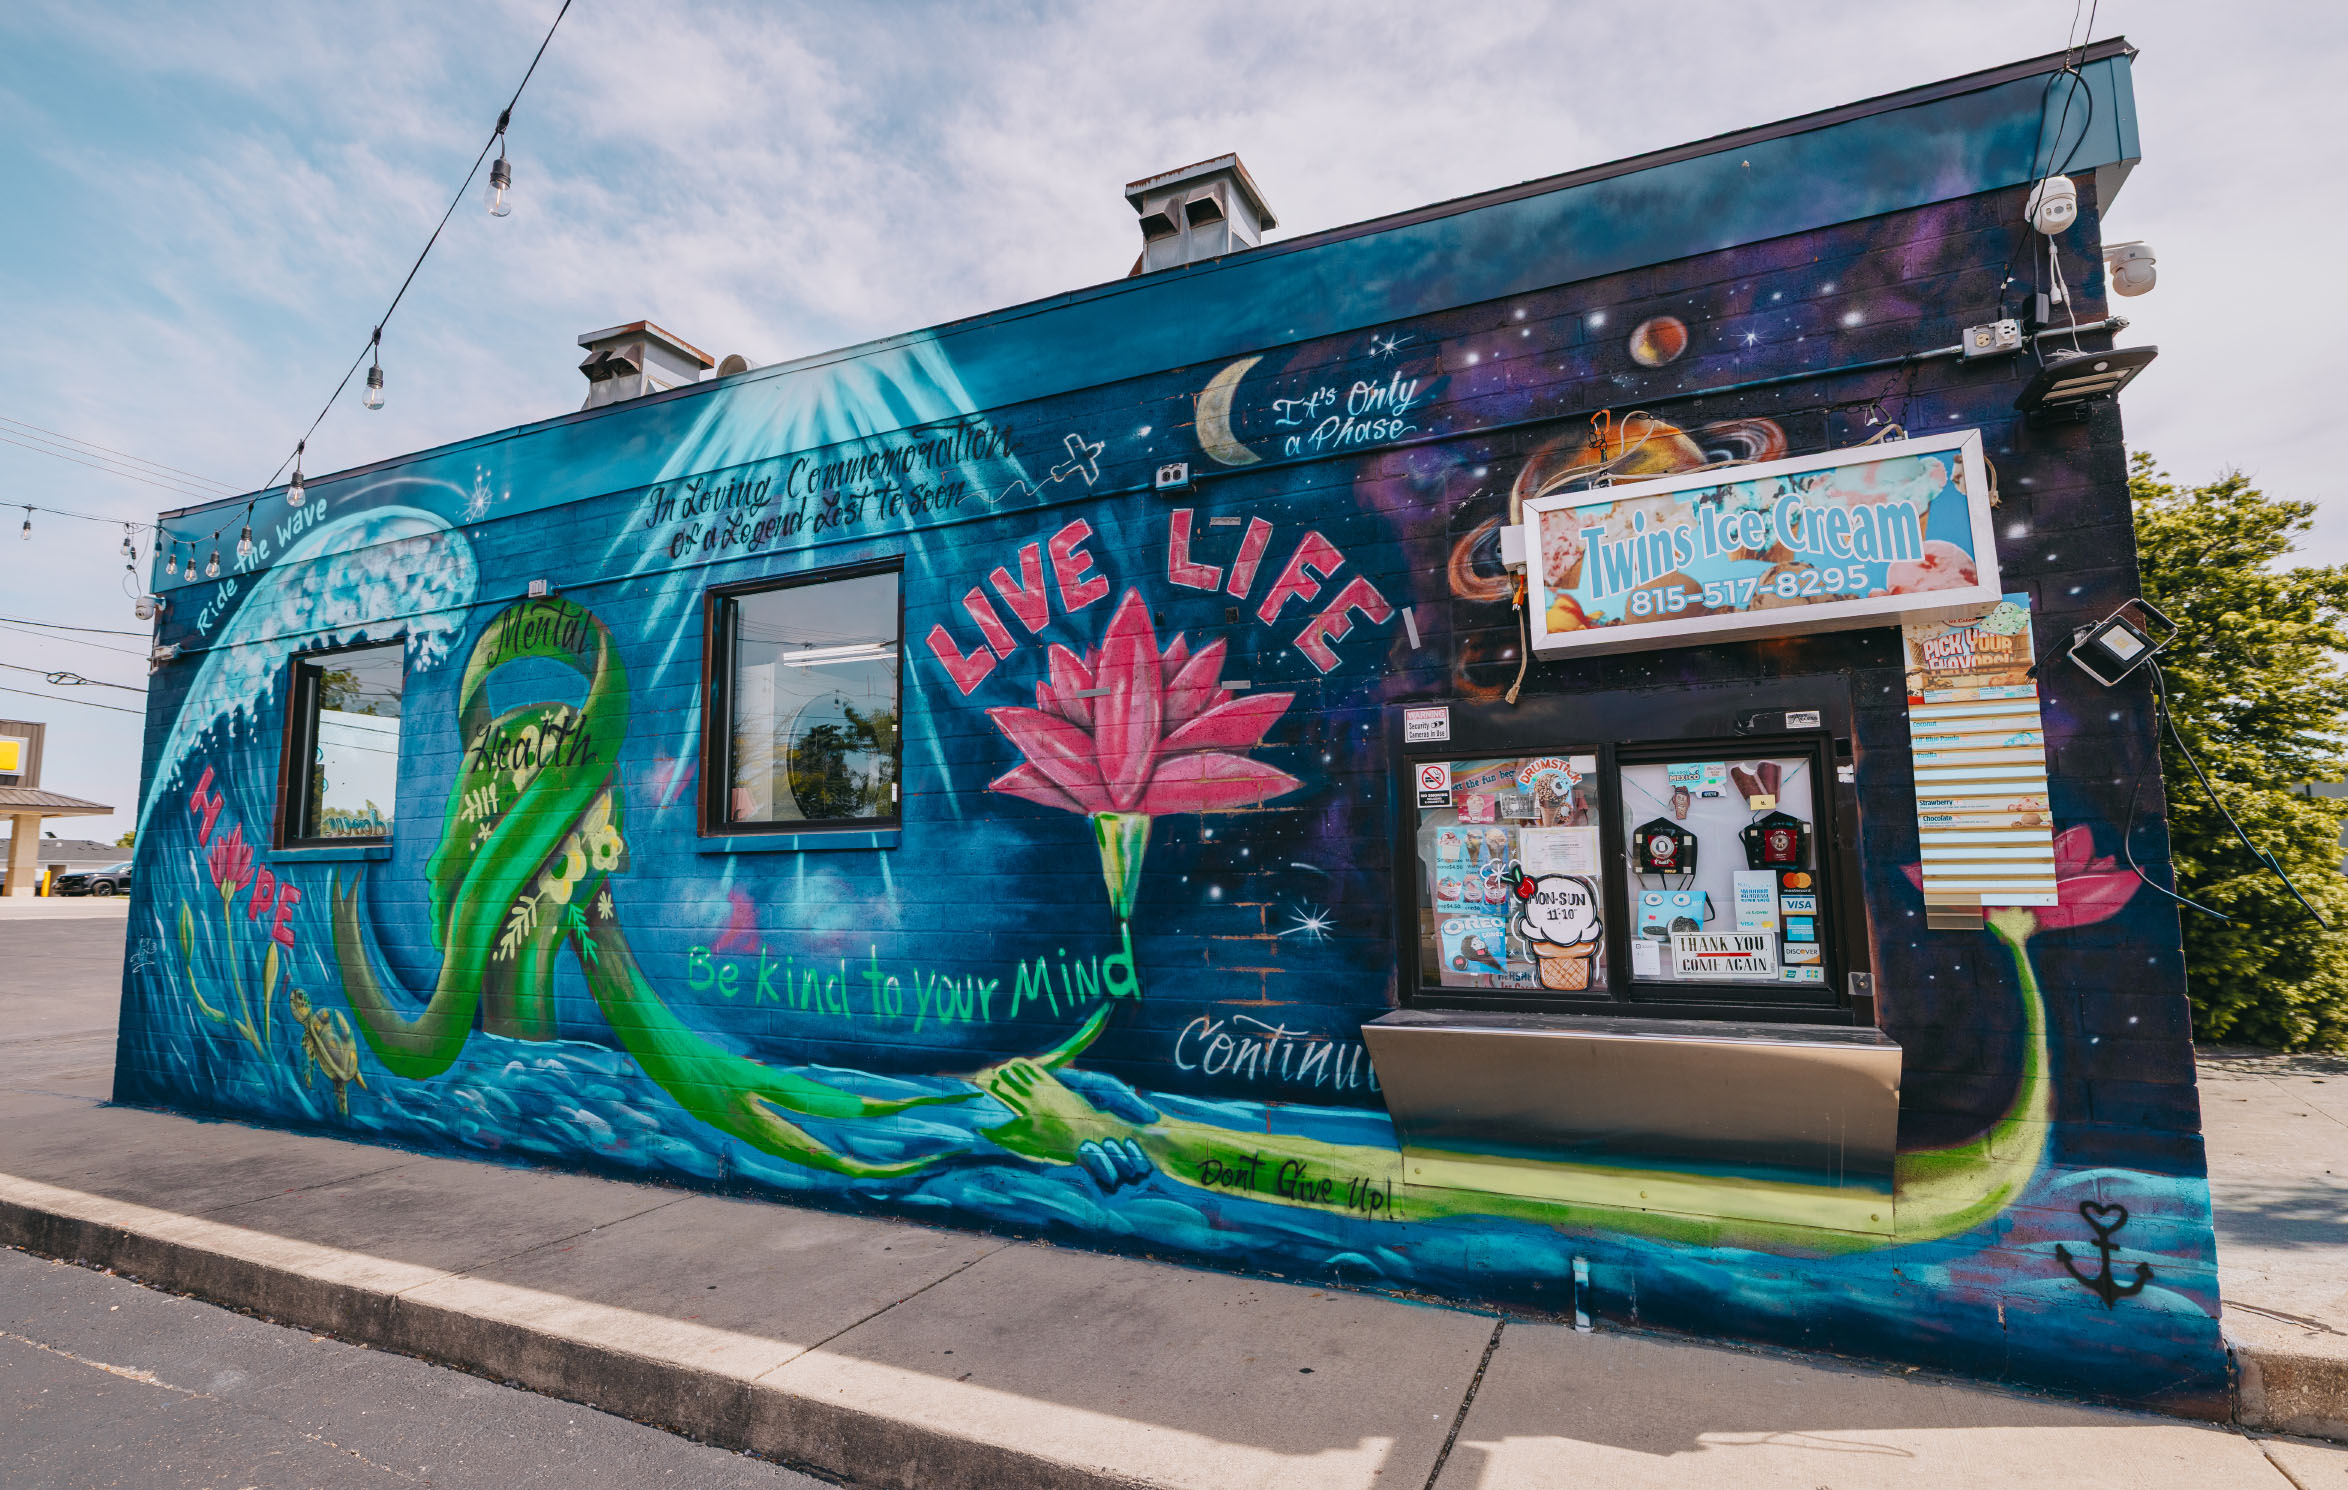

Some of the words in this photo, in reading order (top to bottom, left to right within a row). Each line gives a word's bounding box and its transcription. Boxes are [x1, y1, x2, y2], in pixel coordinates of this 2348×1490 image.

[1272, 386, 1337, 426] It's
[1347, 371, 1421, 416] Only
[1285, 436, 1301, 456] a
[1308, 416, 1417, 451] Phase
[646, 486, 675, 529] In
[682, 475, 772, 519] Loving
[787, 418, 1023, 498] Commemoration
[703, 527, 718, 551] a
[721, 496, 813, 552] Legend
[1578, 509, 1693, 600] Twins
[1699, 505, 1768, 558] Ice
[1773, 494, 1925, 563] Cream
[197, 578, 238, 636] Ride
[234, 539, 270, 574] the
[925, 517, 1110, 696] LIVE
[1168, 507, 1395, 674] LIFE
[1631, 564, 1868, 616] 815-517-8295
[487, 600, 594, 668] Mental
[1922, 632, 1964, 660] PICK
[1964, 628, 2013, 654] YOUR
[1407, 710, 1446, 720] WARNING
[1409, 722, 1429, 730] Security
[471, 714, 599, 774] Health
[1466, 779, 1480, 789] the
[1482, 775, 1496, 785] fun
[1669, 773, 1700, 782] MEXICO
[1443, 917, 1504, 935] OREO
[1786, 900, 1812, 909] VISA
[1680, 936, 1728, 952] THANK
[1682, 958, 1720, 972] COME
[1725, 957, 1767, 971] AGAIN
[688, 945, 740, 998] Be
[756, 943, 852, 1020] kind
[861, 943, 902, 1020] to
[913, 966, 1000, 1033] your
[1175, 1014, 1382, 1092] Continu
[1277, 1160, 1332, 1204] Give
[1348, 1176, 1394, 1222] Up!
